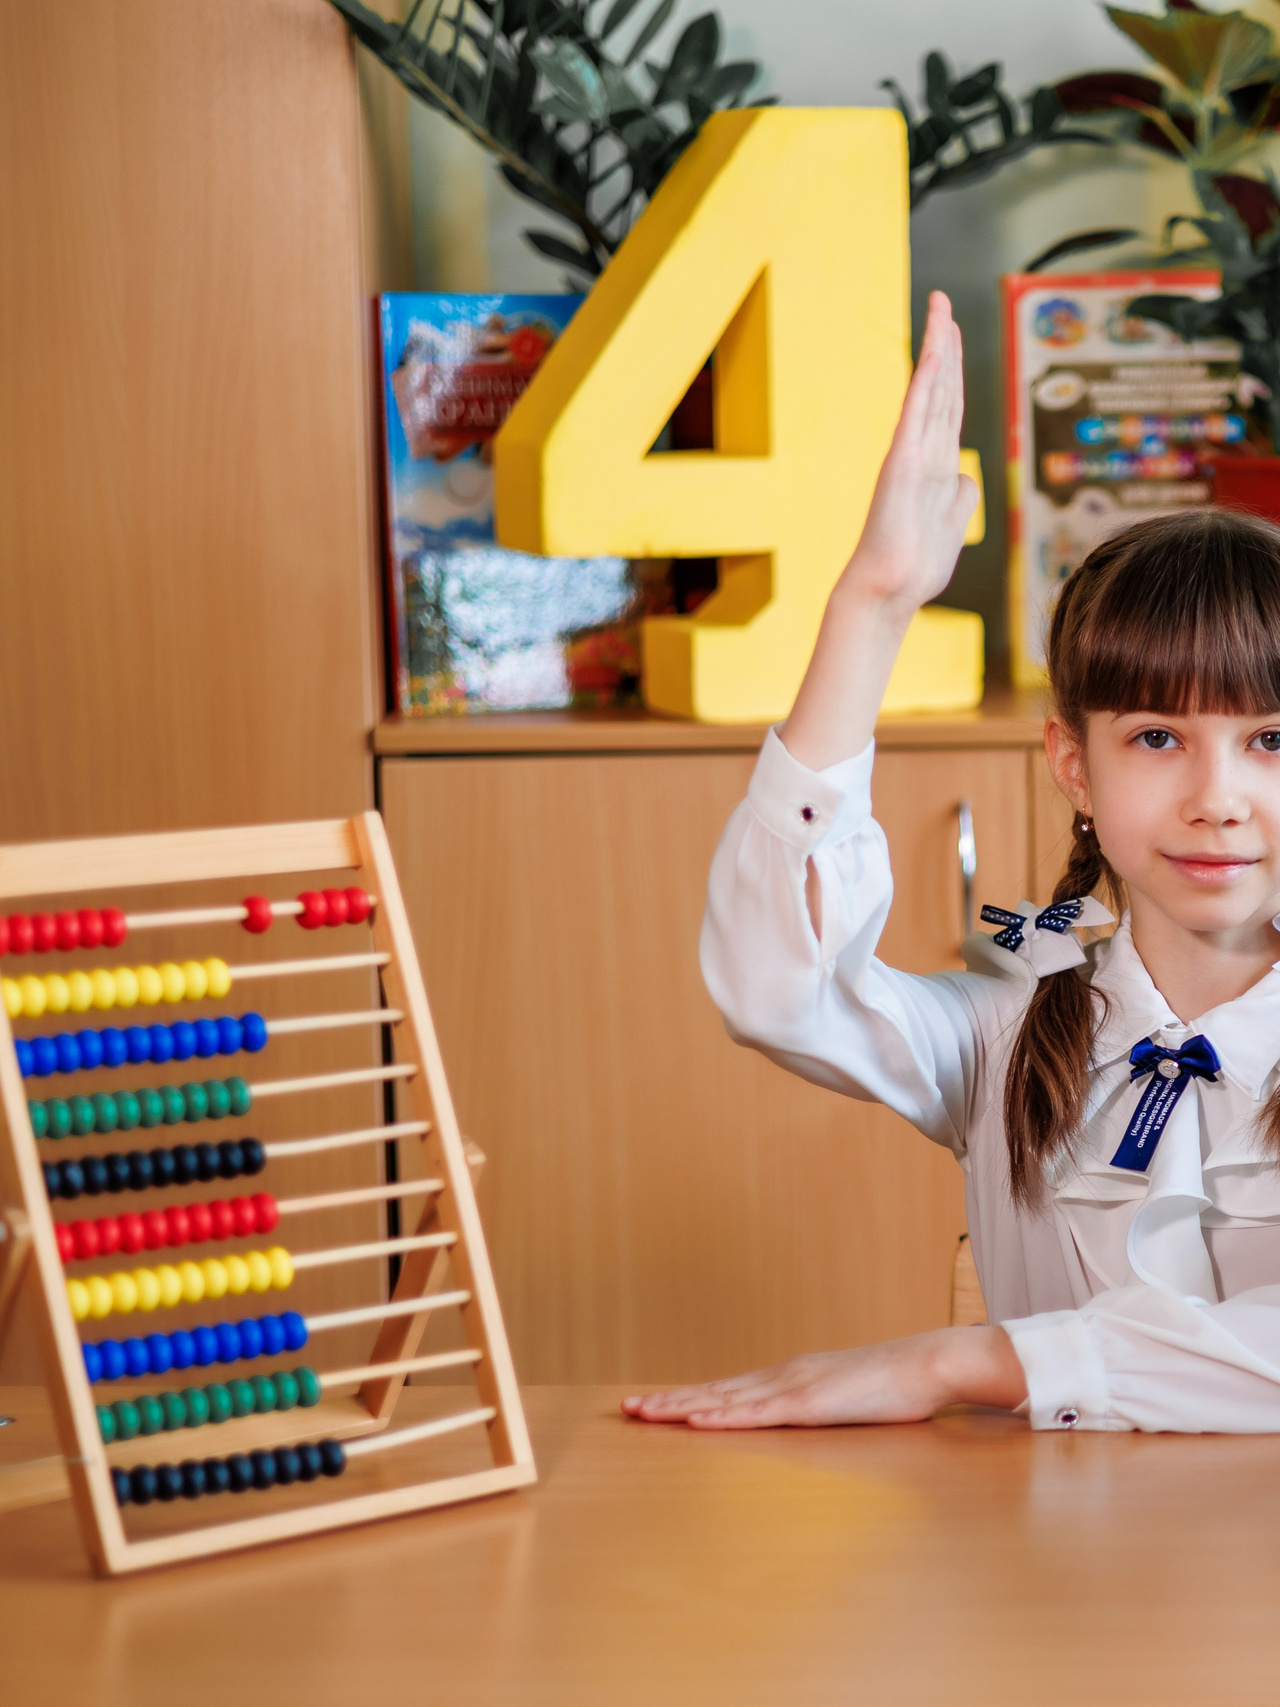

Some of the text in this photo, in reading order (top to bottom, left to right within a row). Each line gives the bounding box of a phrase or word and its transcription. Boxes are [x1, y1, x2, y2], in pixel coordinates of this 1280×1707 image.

[494, 106, 985, 724] 4
[1137, 1078, 1175, 1148] RIGINAL DESIGN BRAND
[1156, 1092, 1178, 1125] HANDMADE
